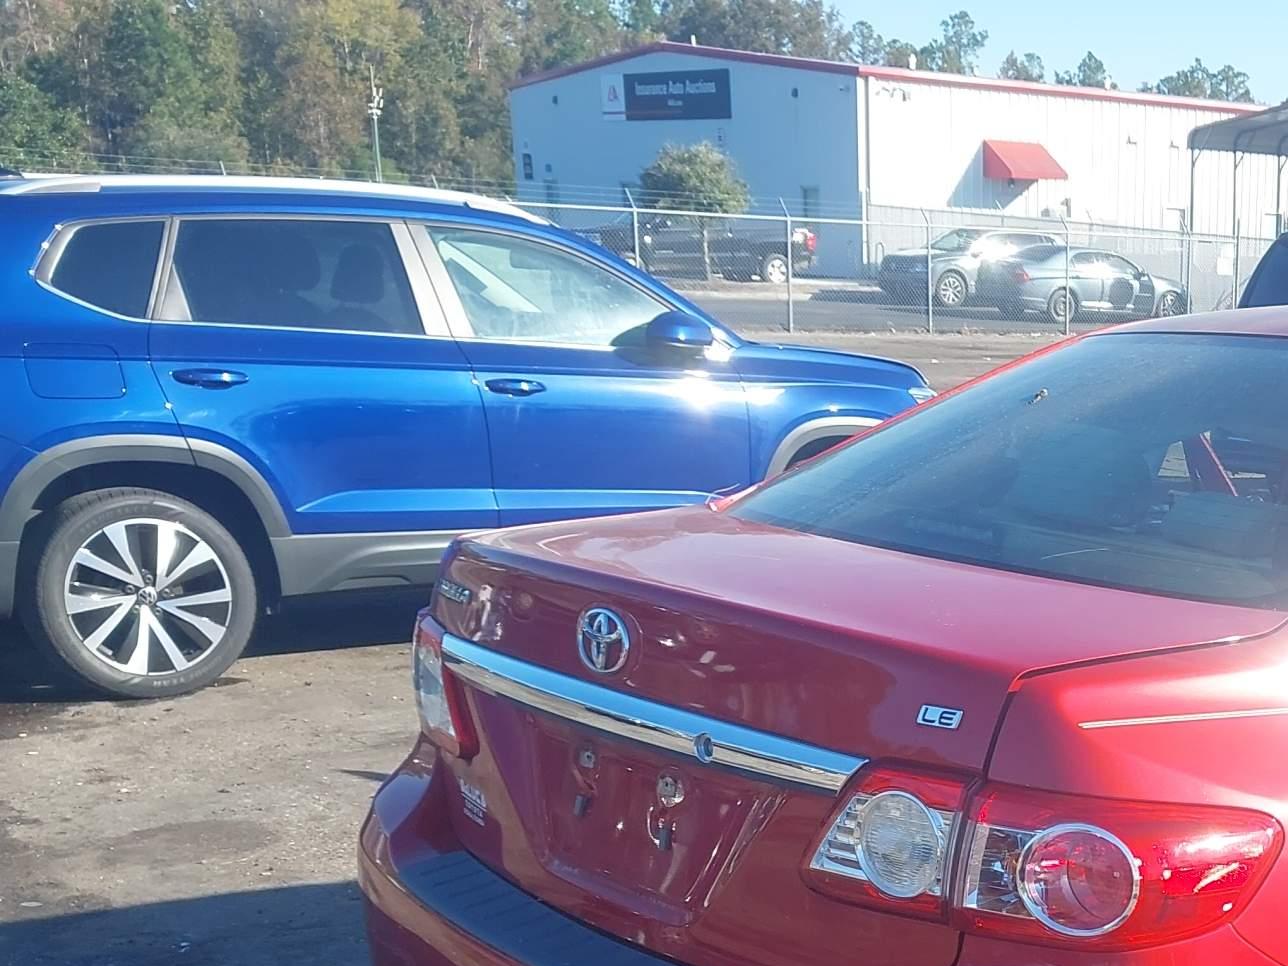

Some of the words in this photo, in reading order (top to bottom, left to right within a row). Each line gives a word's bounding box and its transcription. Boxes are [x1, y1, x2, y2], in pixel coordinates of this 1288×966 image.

[668, 79, 684, 95] Auto
[686, 78, 717, 95] Auctions
[921, 706, 958, 727] LE
